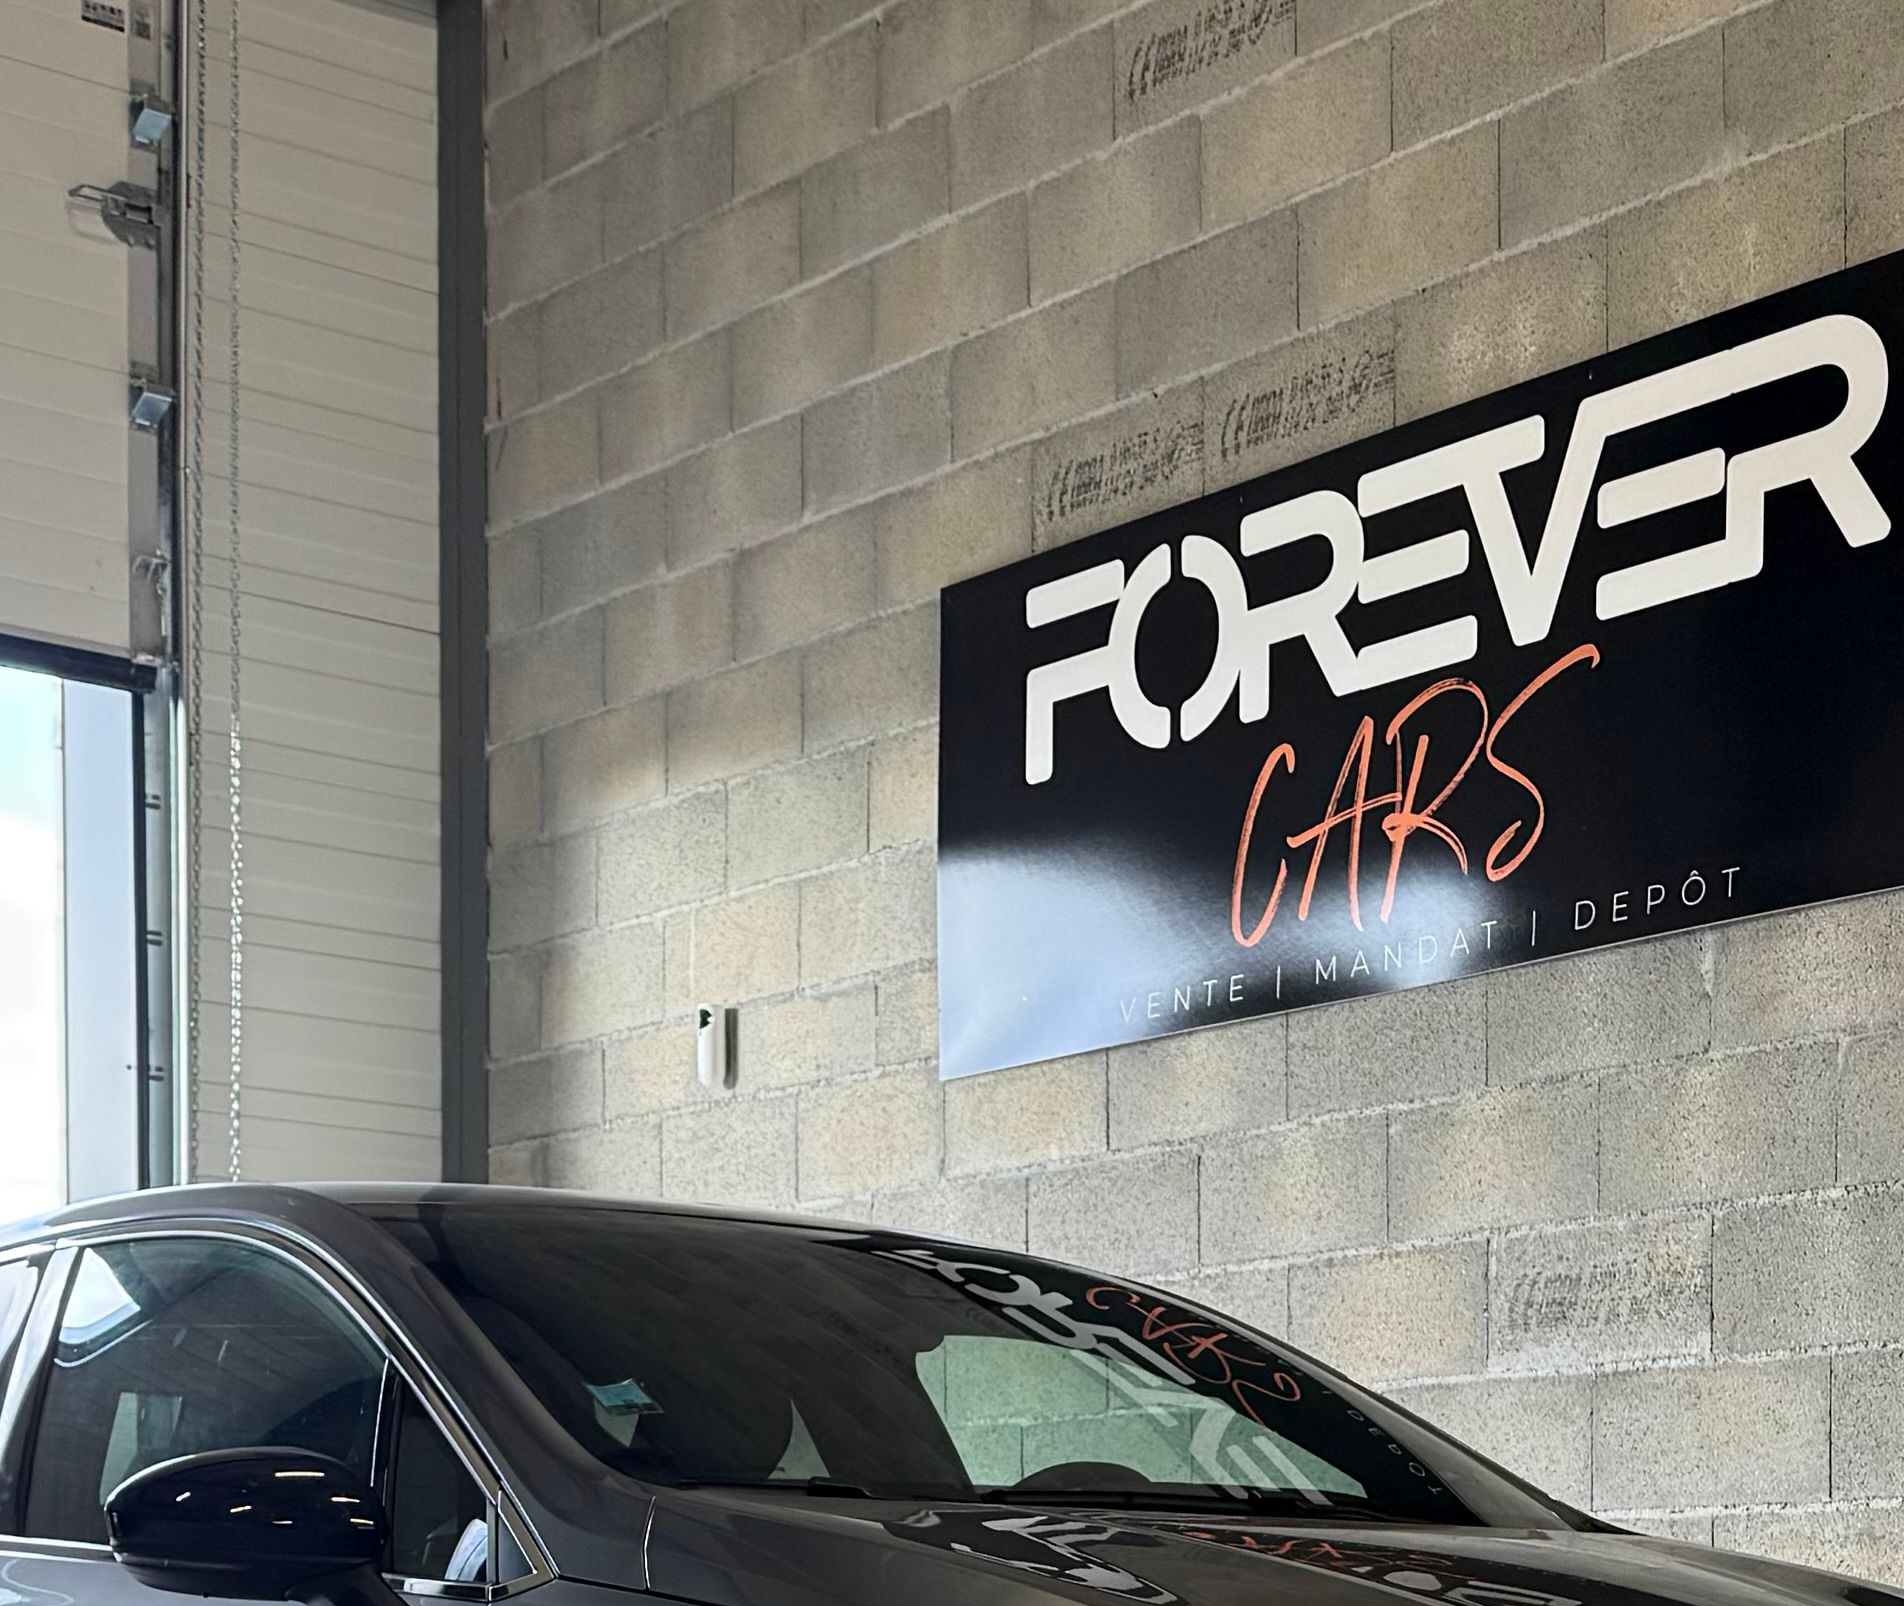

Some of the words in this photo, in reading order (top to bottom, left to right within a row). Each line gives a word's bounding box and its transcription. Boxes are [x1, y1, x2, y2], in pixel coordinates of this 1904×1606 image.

[1025, 314, 1892, 785] FOREVER
[1118, 974, 1246, 1024] VENTE
[1314, 920, 1500, 985] MANDAT
[1573, 867, 1742, 932] DEPÔT
[1230, 643, 1600, 948] CARS
